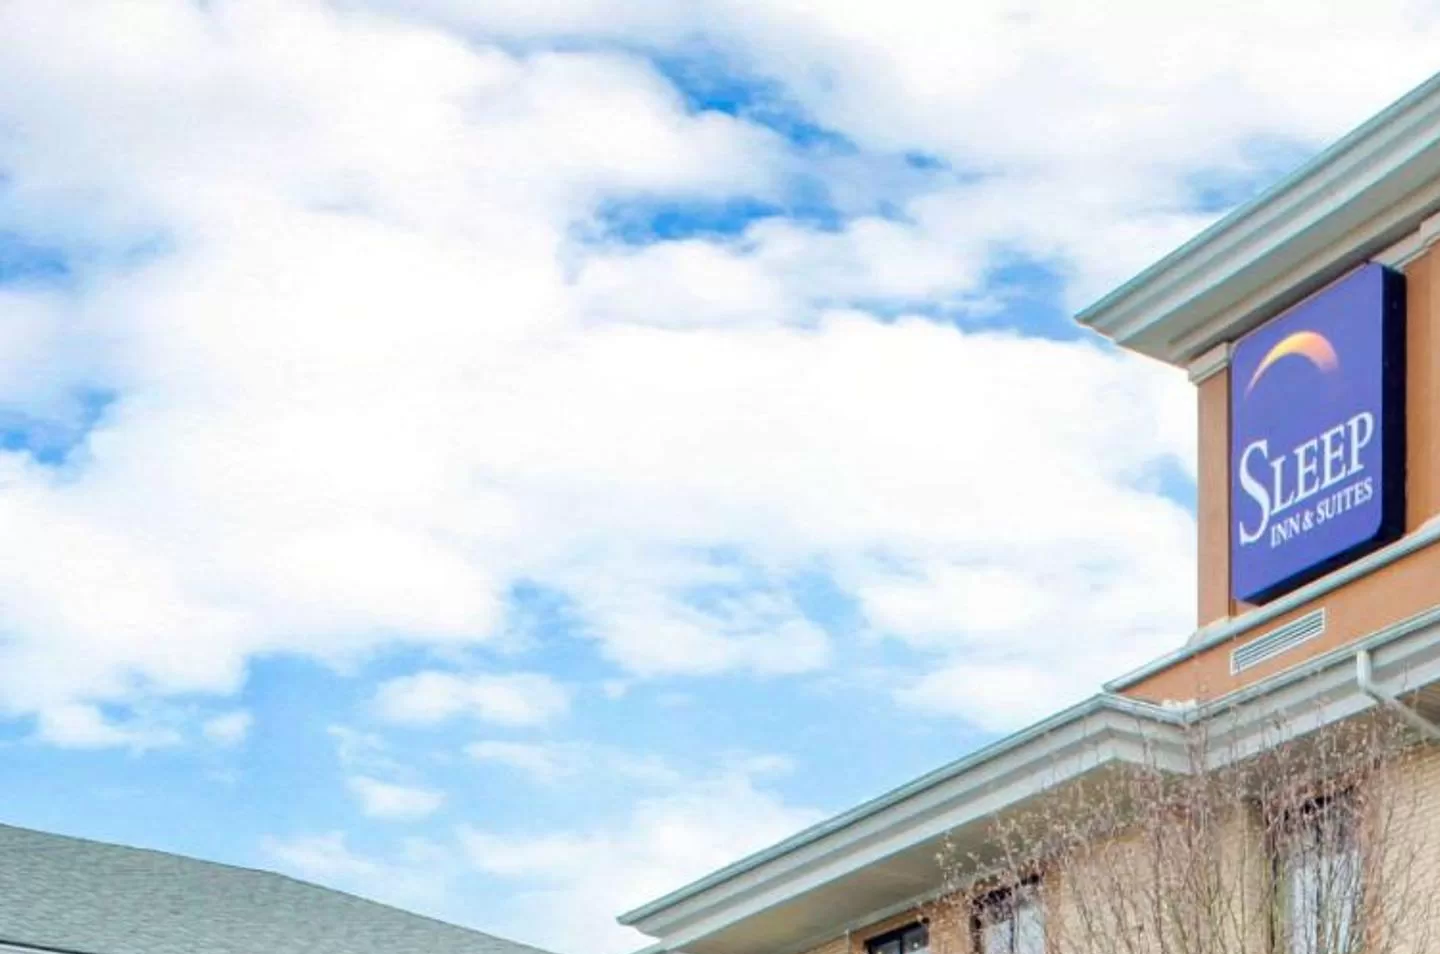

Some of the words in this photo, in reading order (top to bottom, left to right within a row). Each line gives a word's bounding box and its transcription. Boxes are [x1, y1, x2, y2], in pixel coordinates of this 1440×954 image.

[1239, 411, 1374, 546] SLEEP
[1271, 512, 1301, 549] INN
[1302, 509, 1315, 532] &
[1316, 476, 1373, 525] SUITES
